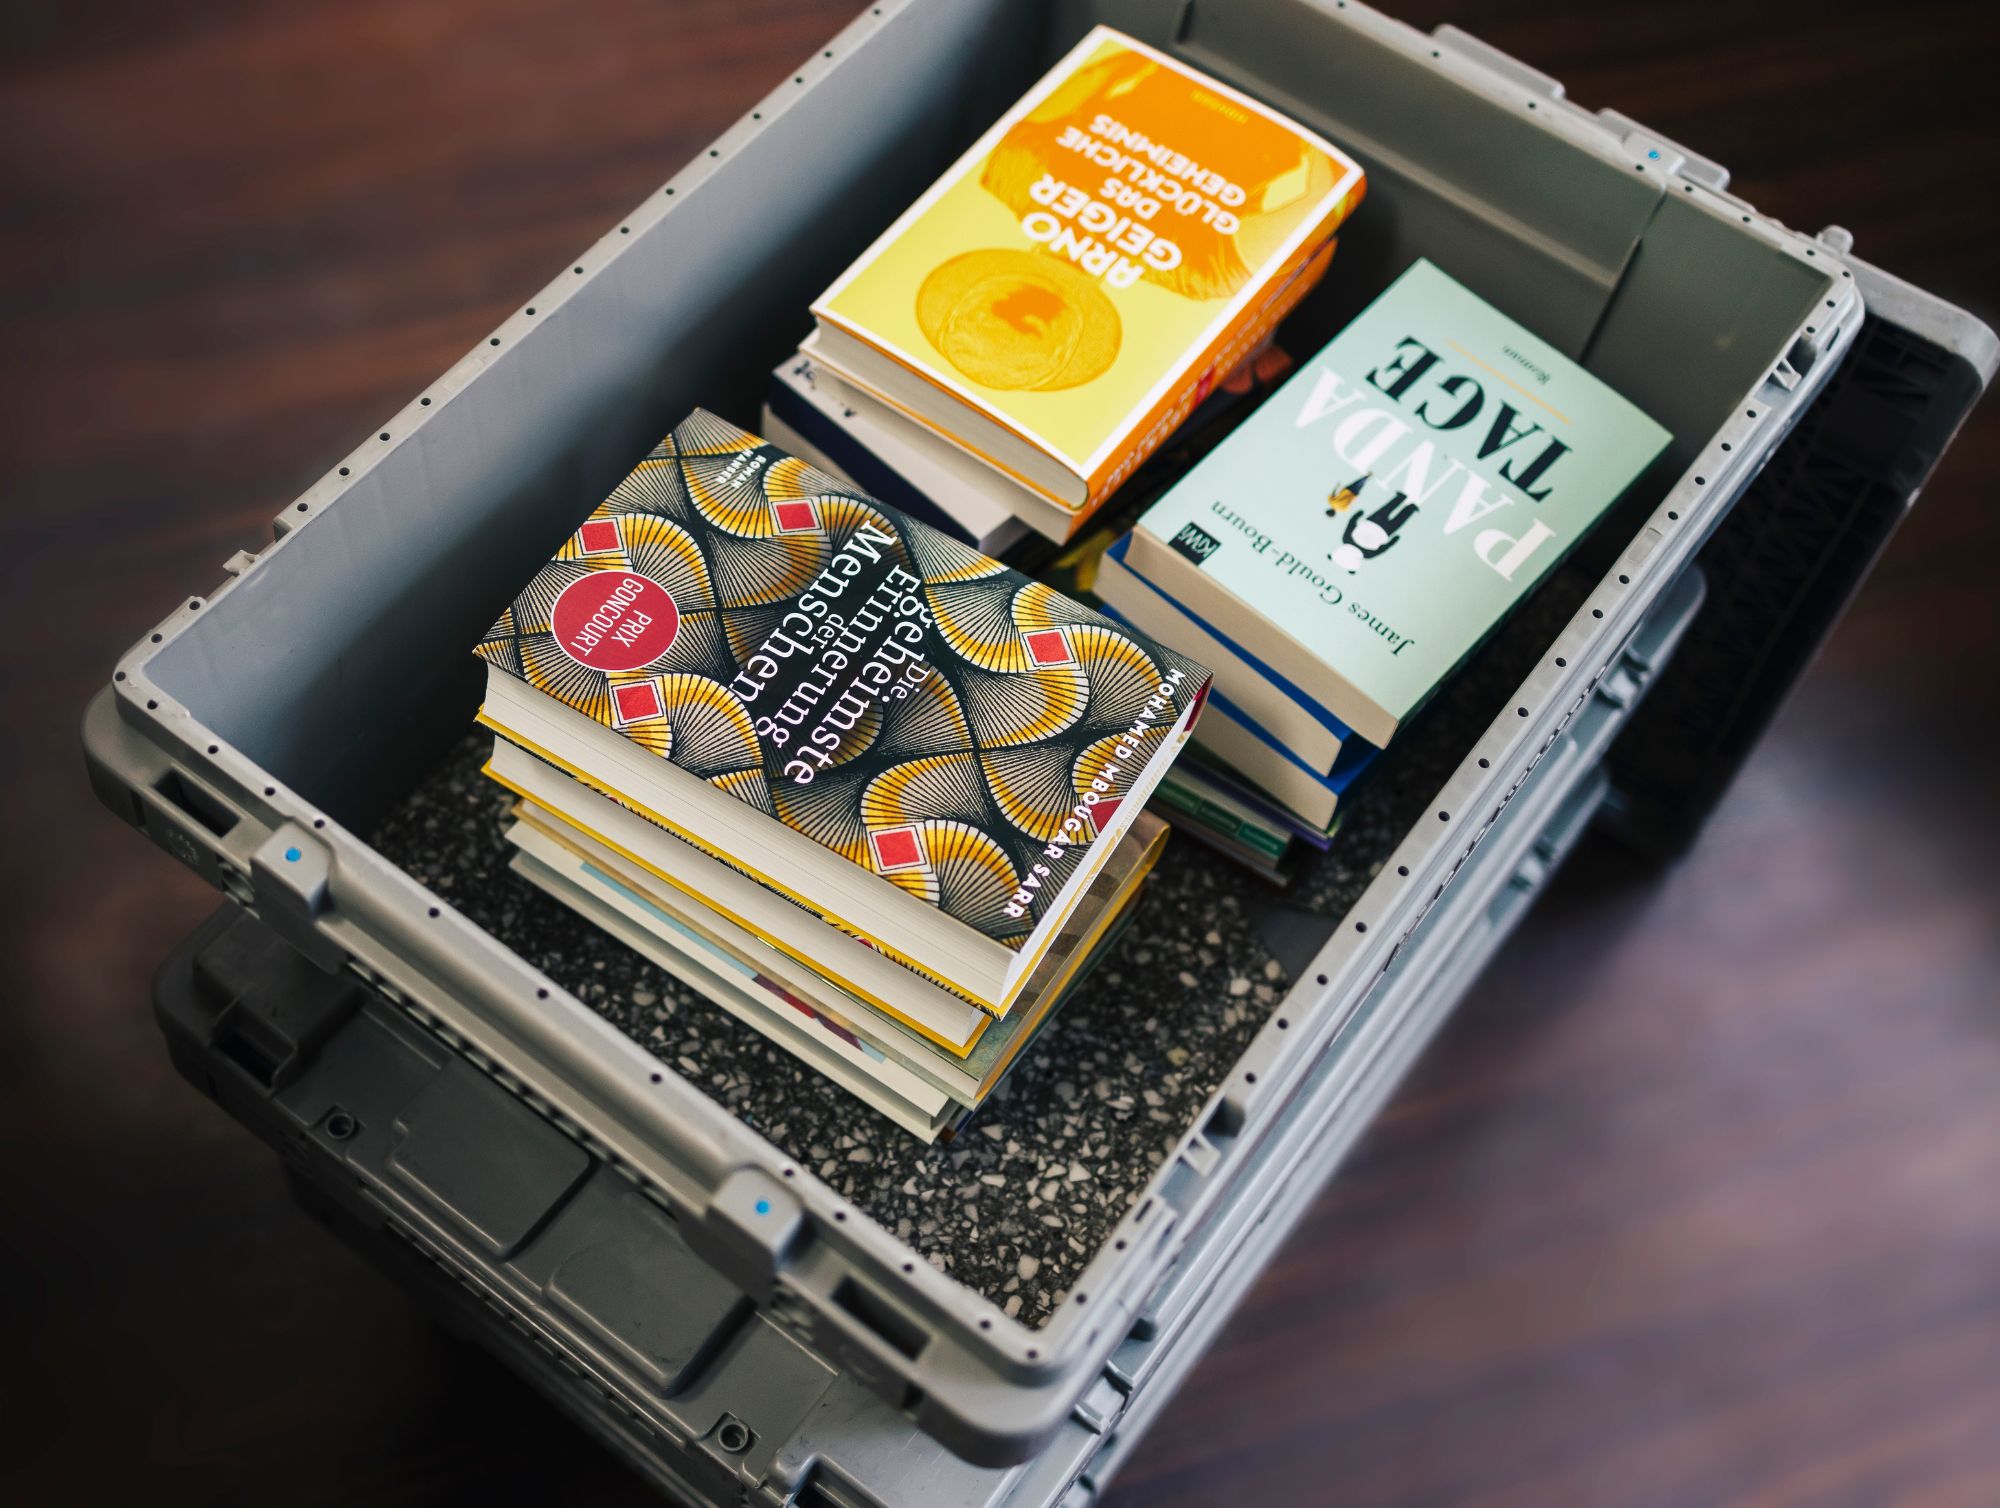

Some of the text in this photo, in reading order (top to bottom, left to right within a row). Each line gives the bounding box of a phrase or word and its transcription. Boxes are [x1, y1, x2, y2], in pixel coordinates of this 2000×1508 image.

[1056, 126, 1240, 235] GLÜCKLICHE
[1089, 114, 1246, 207] GEHEIMNIS
[1099, 177, 1162, 220] DAS
[1022, 211, 1145, 288] ARNO
[1029, 174, 1182, 271] GEIGER
[716, 448, 755, 484] HANSER
[1365, 336, 1573, 503] TAGE
[731, 455, 767, 489] ROMAN
[1295, 366, 1556, 582] PANDA
[571, 578, 644, 656] GONCOURT
[729, 520, 898, 702] Menschen
[1212, 501, 1415, 656] James Gould-Bourn
[611, 610, 653, 648] PRIX
[755, 564, 921, 748] Erinnerung
[811, 613, 844, 649] der
[784, 595, 933, 784] geheimste
[890, 661, 931, 700] Die
[1003, 668, 1186, 918] MOHAMED MBOUGAR SARR
